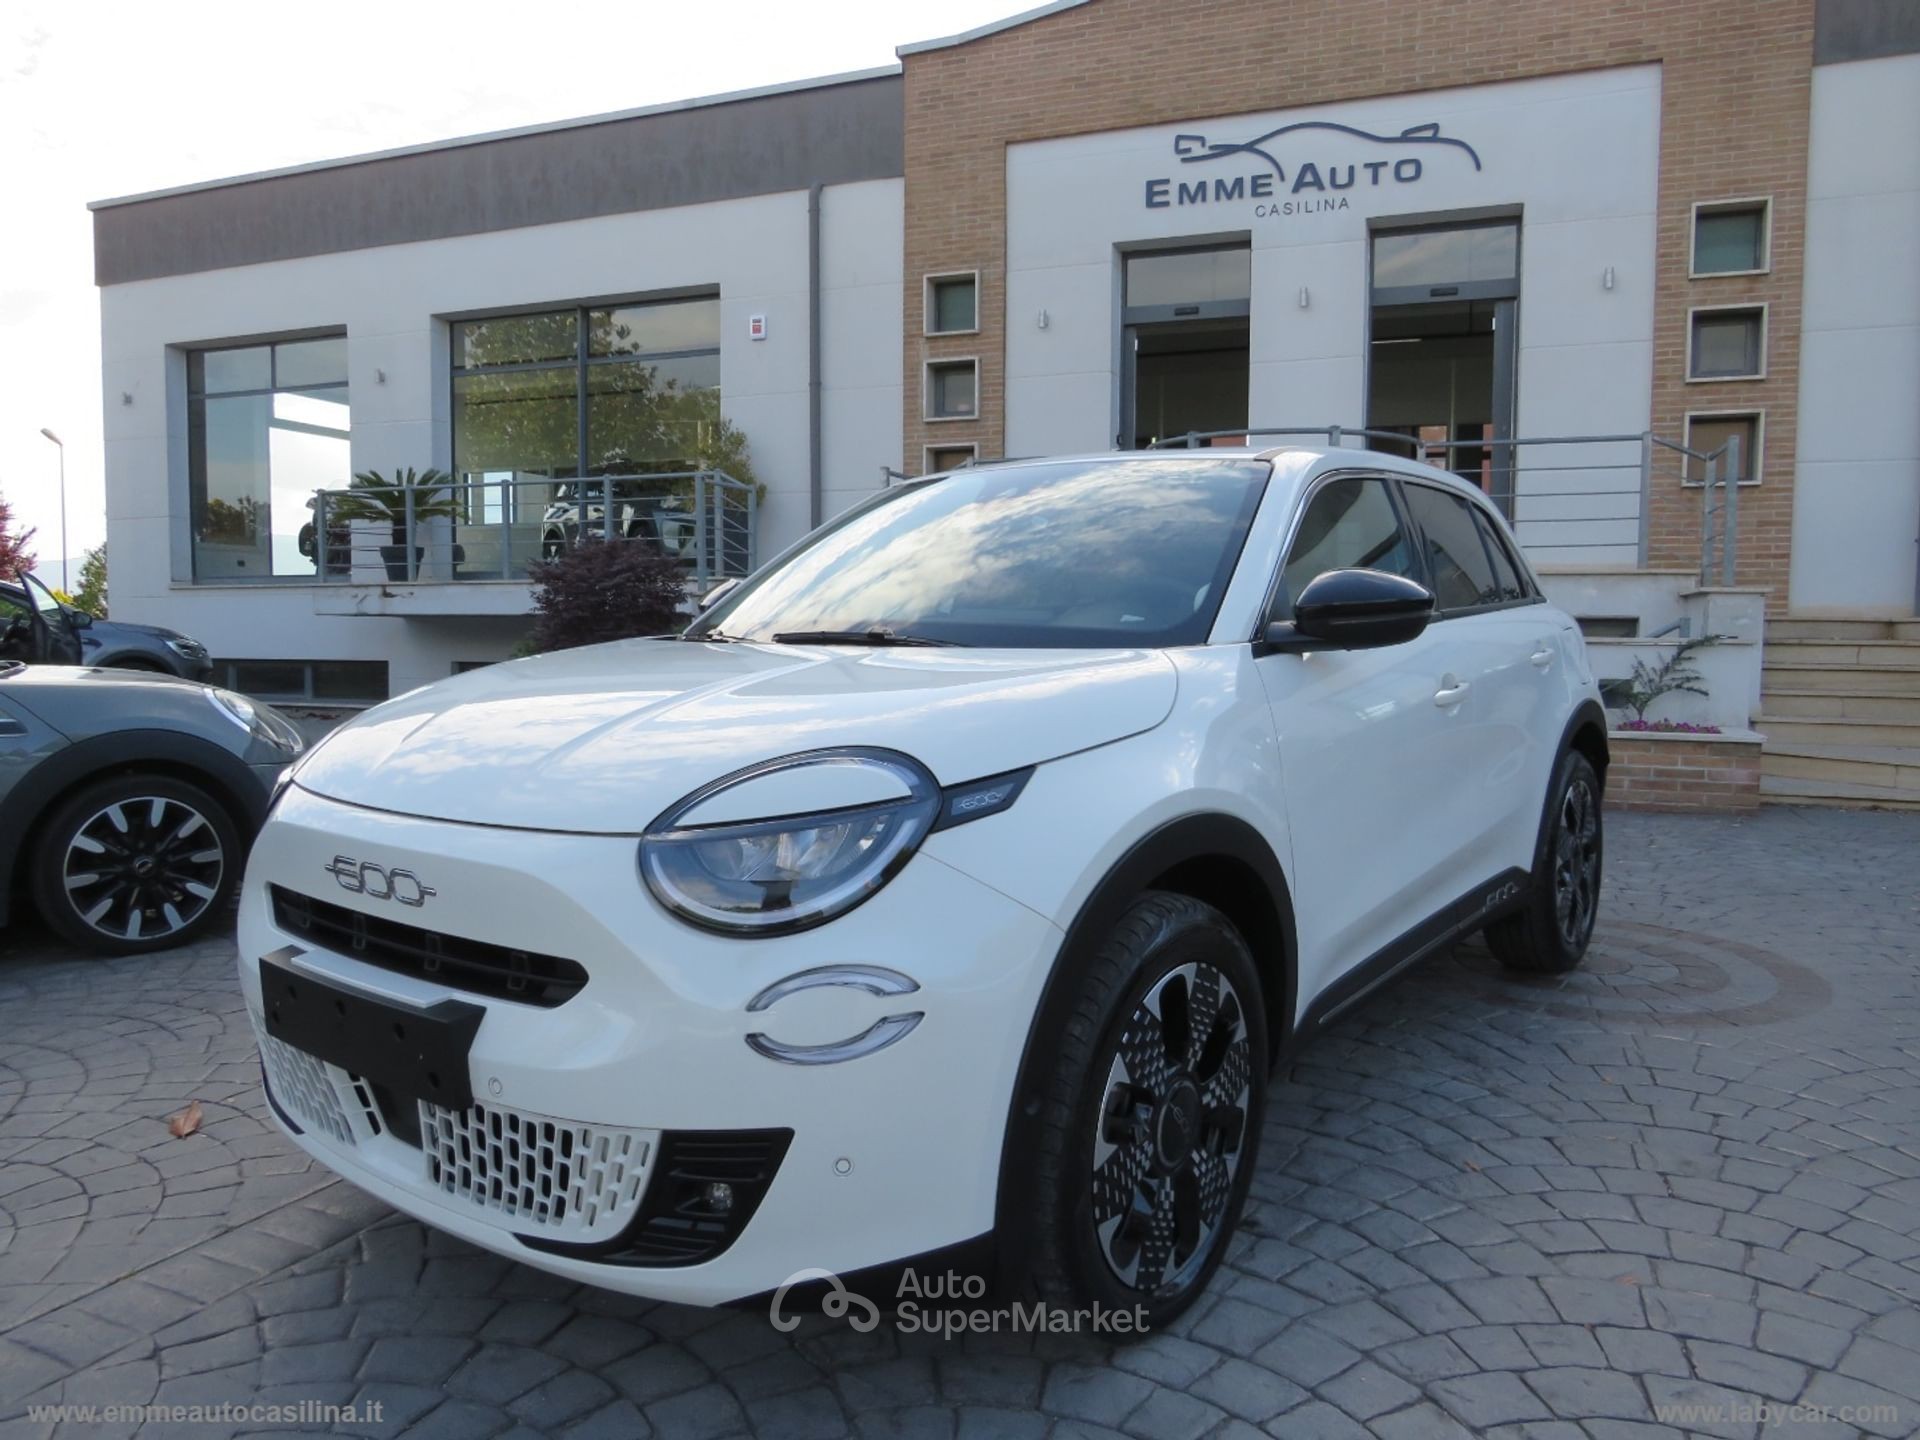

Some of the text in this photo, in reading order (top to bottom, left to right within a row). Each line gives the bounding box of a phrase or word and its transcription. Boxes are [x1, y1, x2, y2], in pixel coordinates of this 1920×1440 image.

[1145, 158, 1423, 209] EMME AUTO
[1255, 197, 1350, 218] CASILINA
[325, 854, 437, 908] 600
